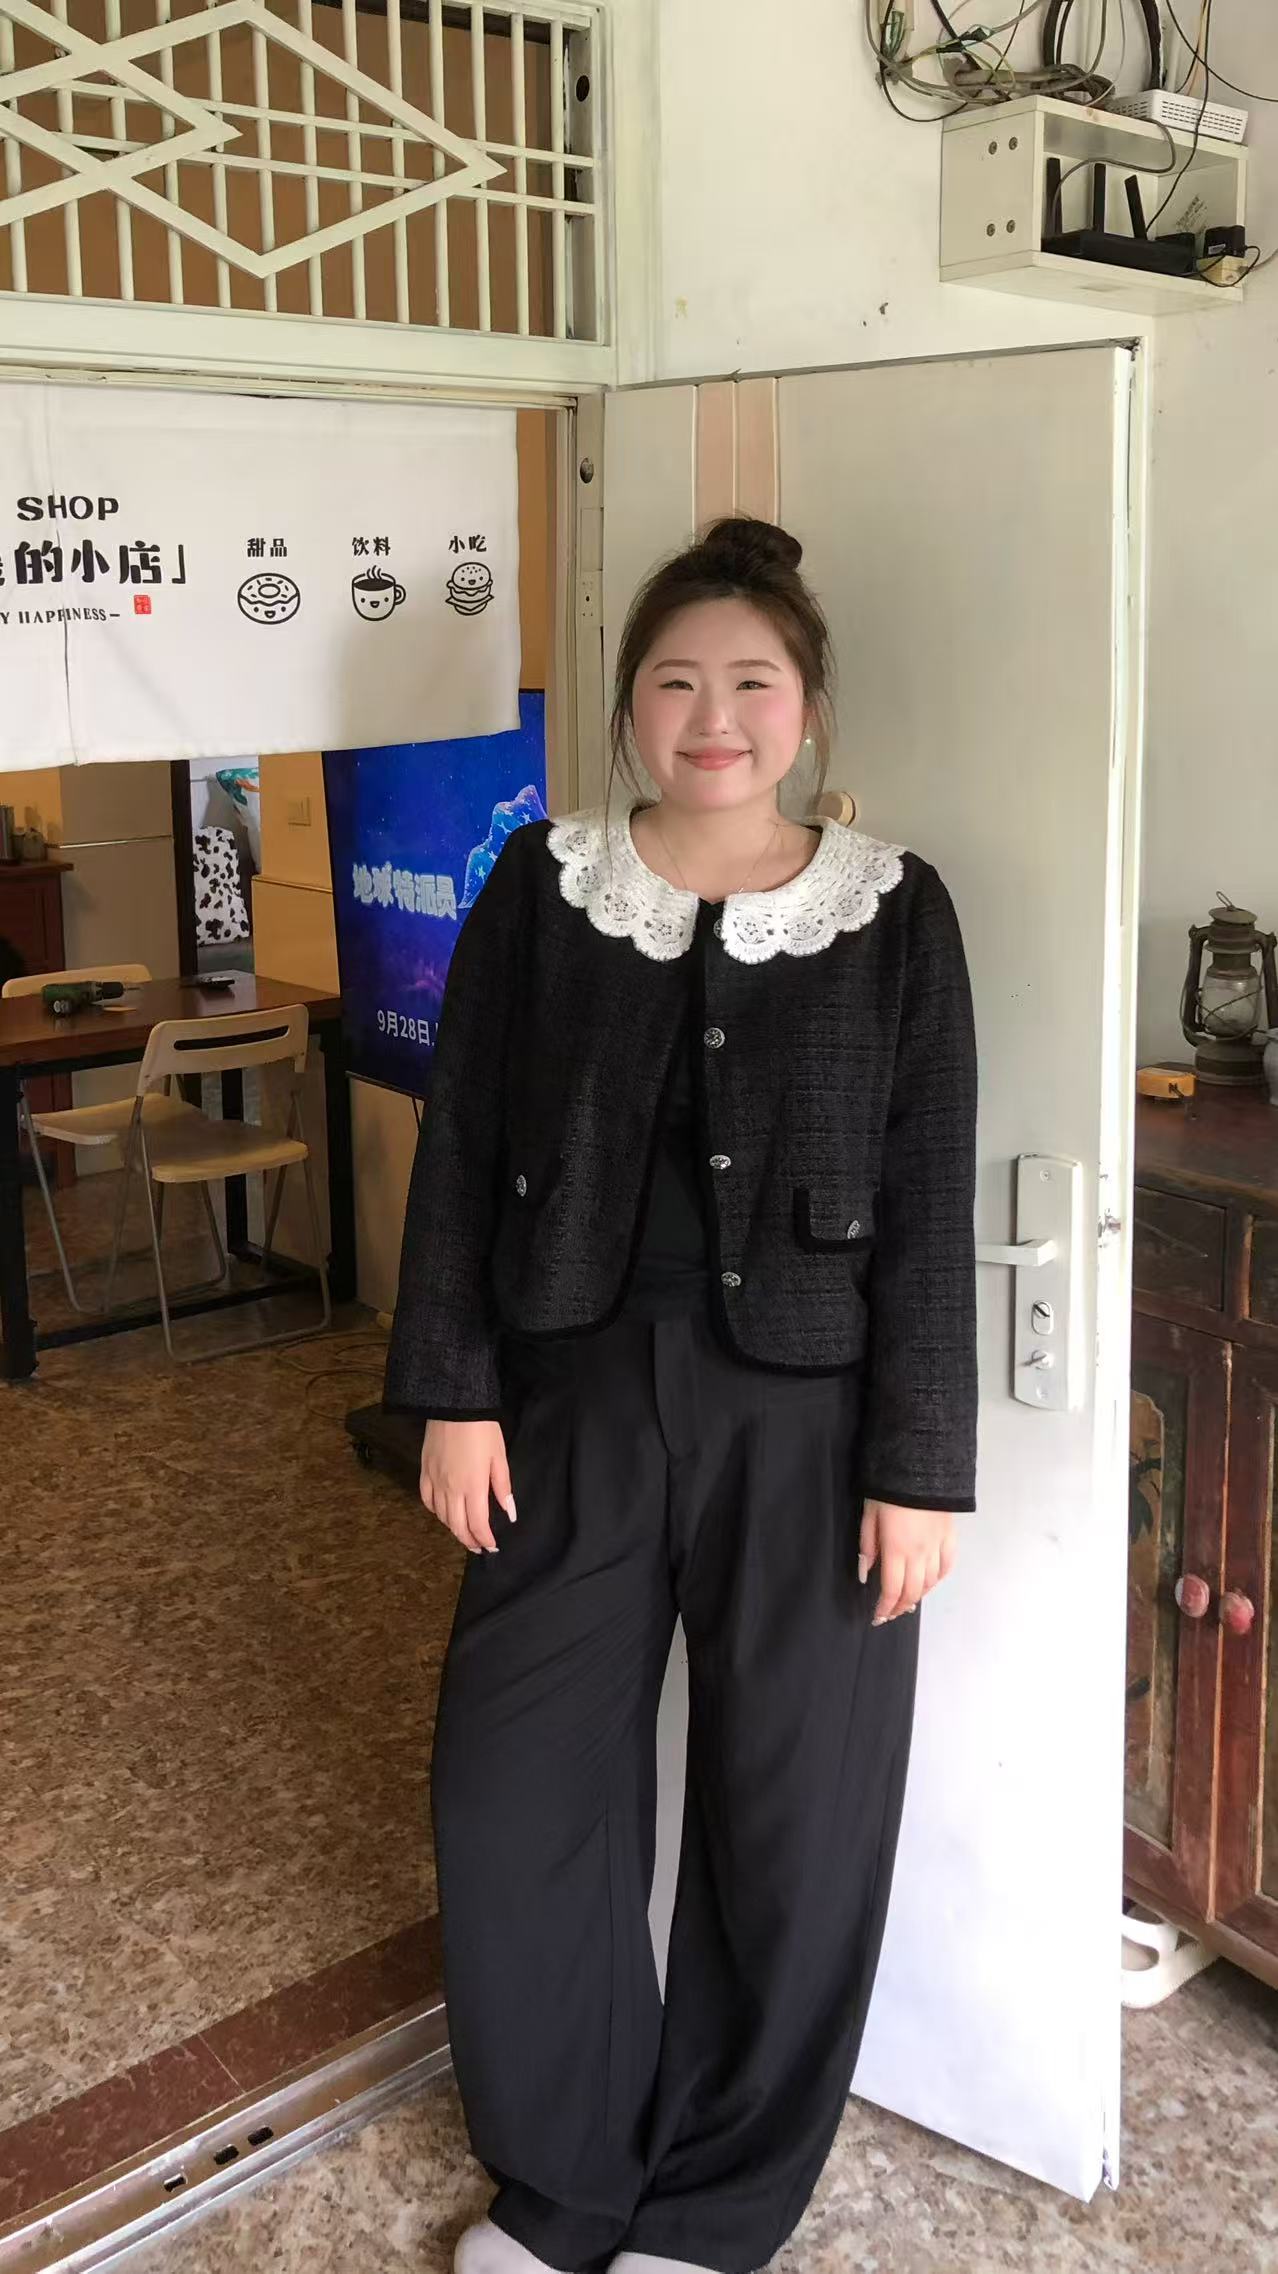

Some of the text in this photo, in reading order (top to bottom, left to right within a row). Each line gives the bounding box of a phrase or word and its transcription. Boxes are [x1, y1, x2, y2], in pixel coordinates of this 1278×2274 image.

[17, 495, 119, 521] SHOP
[247, 538, 287, 557] 甜品
[352, 537, 390, 555] 饮料
[449, 535, 487, 553] 小吃
[0, 539, 186, 585] 的小店」
[353, 862, 457, 920] 地球特派员
